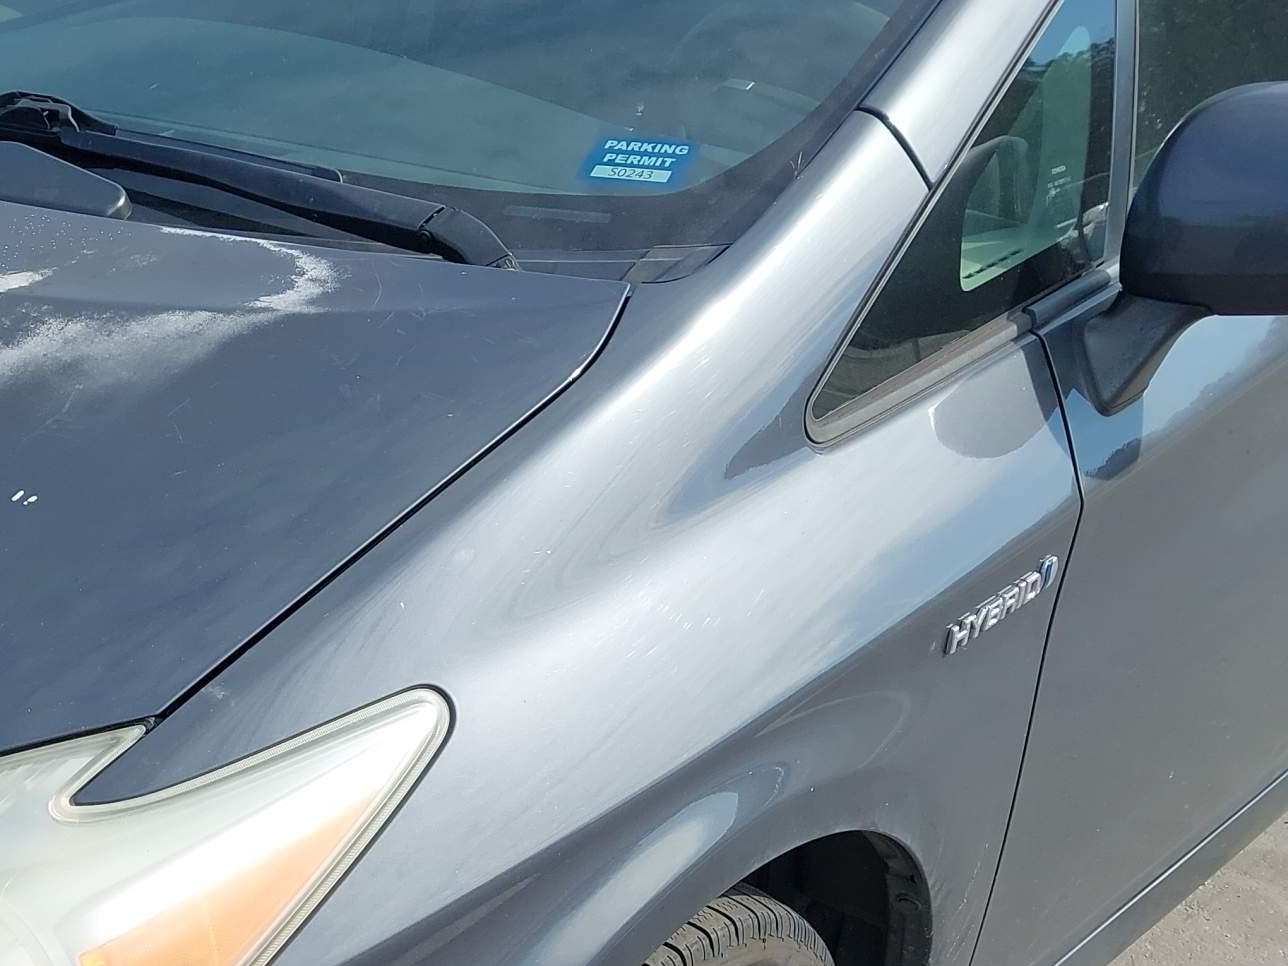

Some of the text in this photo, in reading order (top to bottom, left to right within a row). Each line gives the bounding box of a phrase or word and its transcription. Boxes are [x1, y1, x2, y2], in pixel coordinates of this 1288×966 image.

[604, 140, 689, 154] PARKING
[603, 153, 676, 167] PERMIT
[944, 571, 1042, 655] HYBRID
